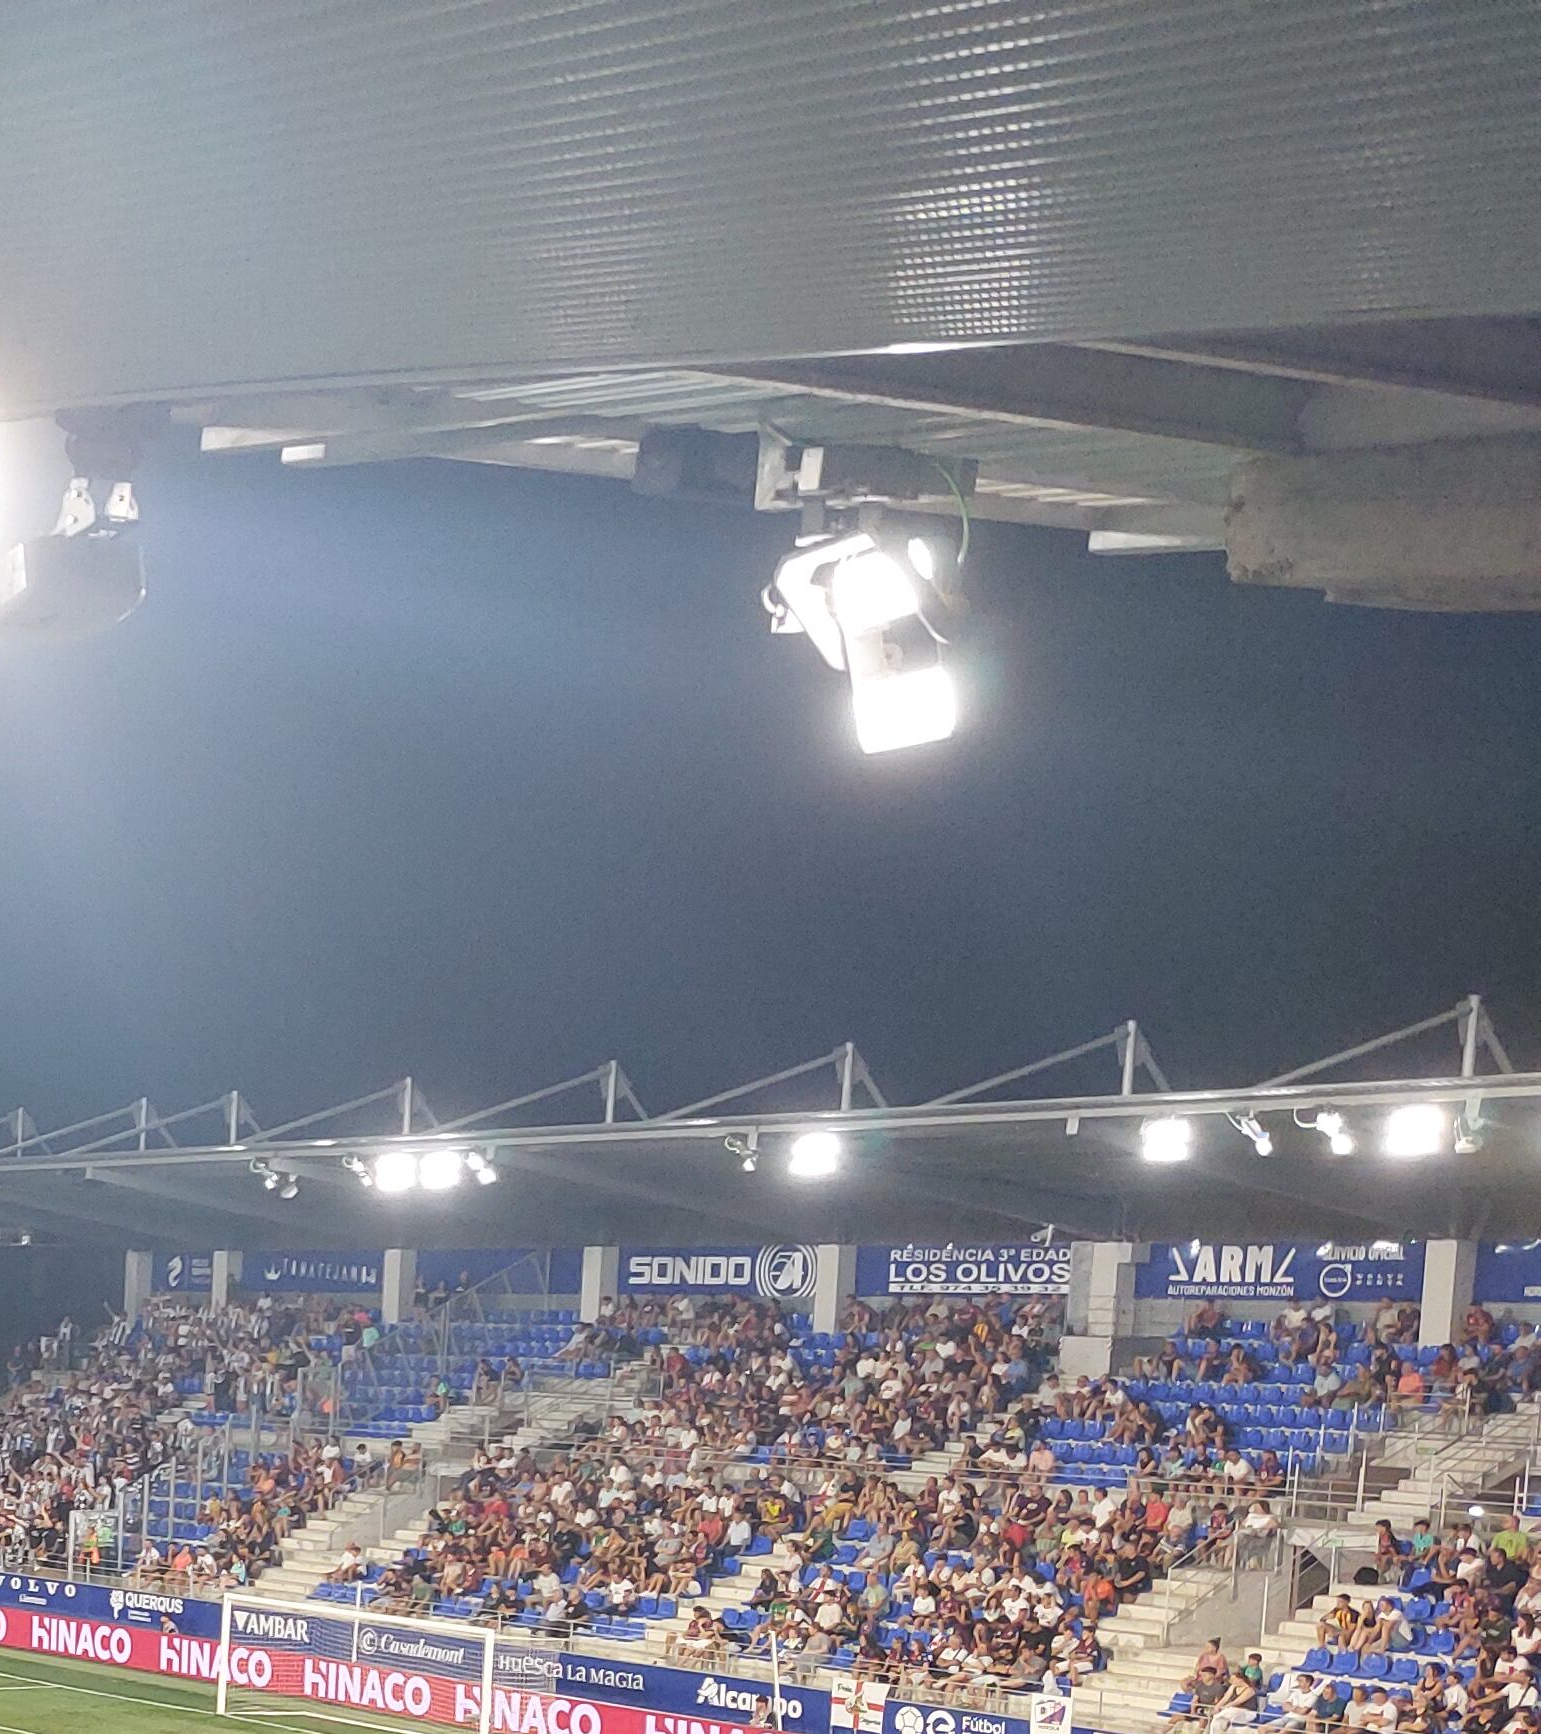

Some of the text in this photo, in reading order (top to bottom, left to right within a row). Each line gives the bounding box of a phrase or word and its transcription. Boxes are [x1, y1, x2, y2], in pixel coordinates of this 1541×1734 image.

[1020, 1249, 1070, 1262] EDAD
[628, 1256, 752, 1286] SONIDO
[889, 1263, 1070, 1283] LOS OLIVOS
[1167, 1284, 1255, 1296] AUTOREPARACIONES
[31, 1615, 132, 1664] HINACO
[245, 1615, 310, 1644] AMBAR
[159, 1635, 273, 1688] HINACO
[381, 1633, 465, 1665] Casademont
[303, 1657, 432, 1717] HINACO
